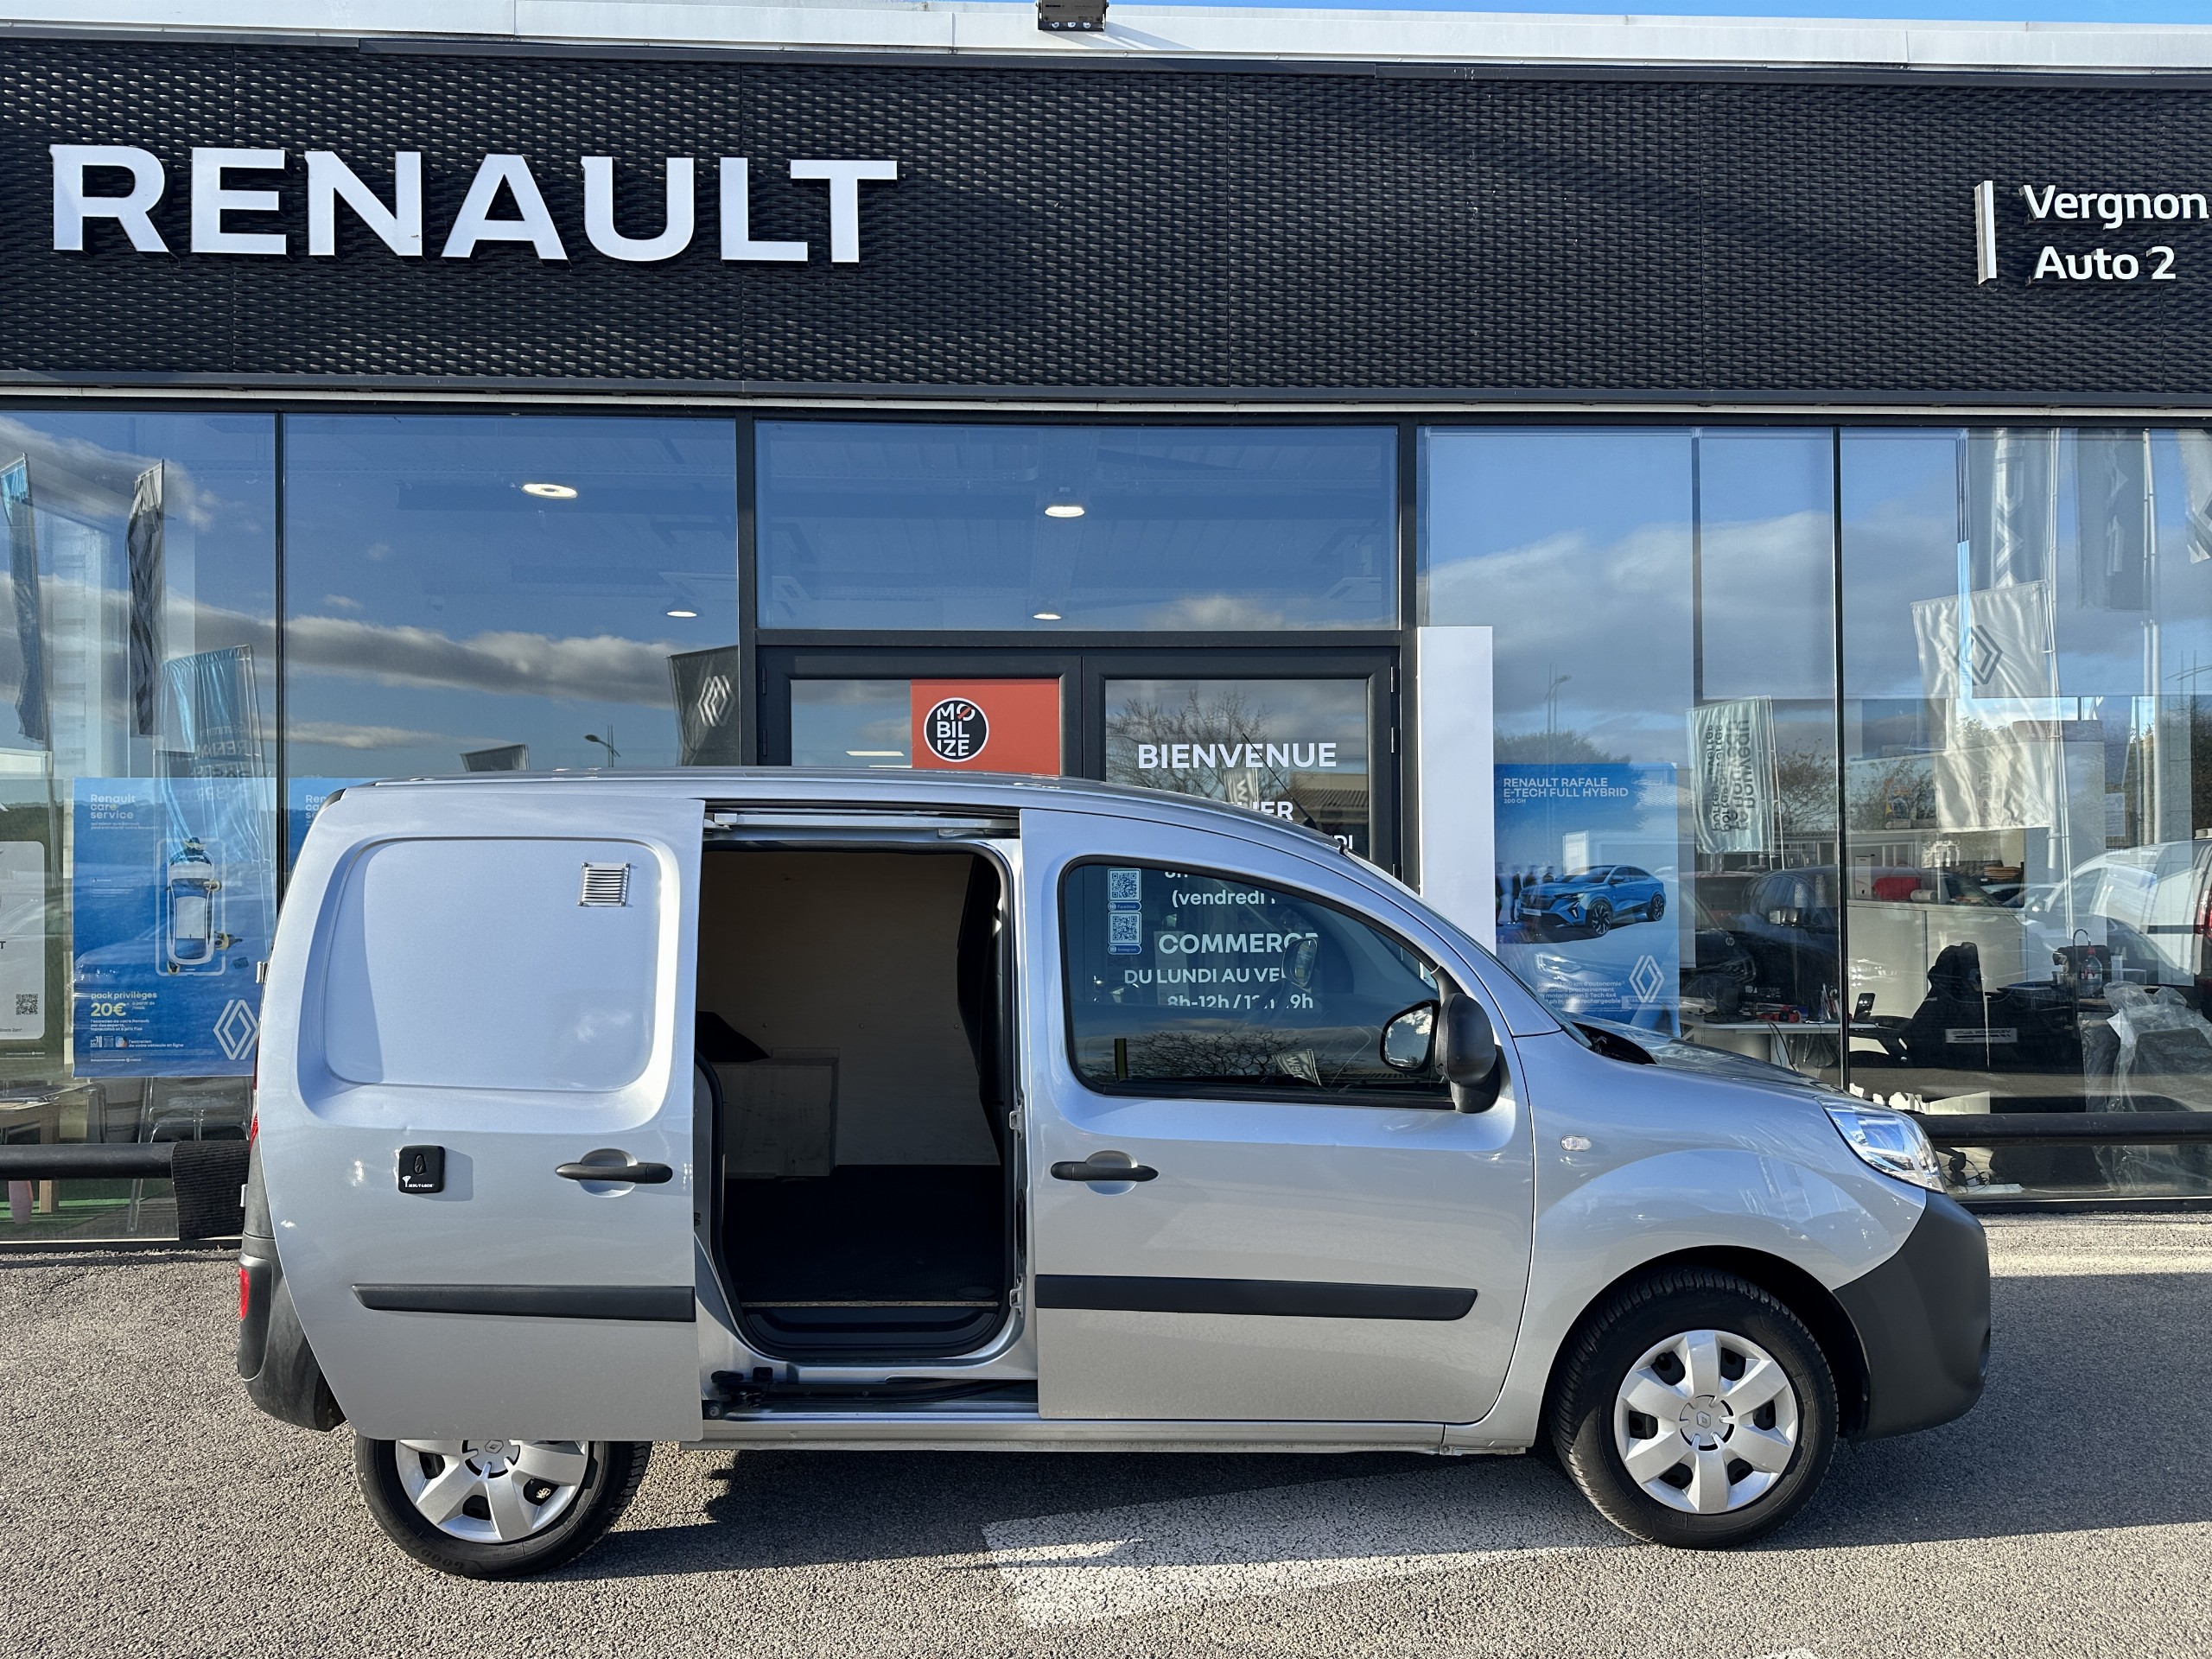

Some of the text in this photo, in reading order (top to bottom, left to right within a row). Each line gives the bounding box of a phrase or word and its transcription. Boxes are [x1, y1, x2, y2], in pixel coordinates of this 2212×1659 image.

[49, 143, 897, 263] RENAULT
[2020, 184, 2209, 230] Vergnon
[2031, 245, 2177, 281] Auto 2
[1138, 742, 1337, 769] BIENVENUE
[1503, 777, 1608, 788] RENAULT RAFALE
[90, 793, 136, 803] Renault
[1503, 787, 1629, 798] E-TECH FULL HYBRID
[90, 803, 118, 811] care
[90, 810, 134, 819] service
[1159, 932, 1319, 955] COMMERC
[1124, 969, 1152, 984] DU
[1156, 968, 1217, 983] LUNDI
[1221, 968, 1249, 982] AU
[114, 991, 157, 1001] privilèges
